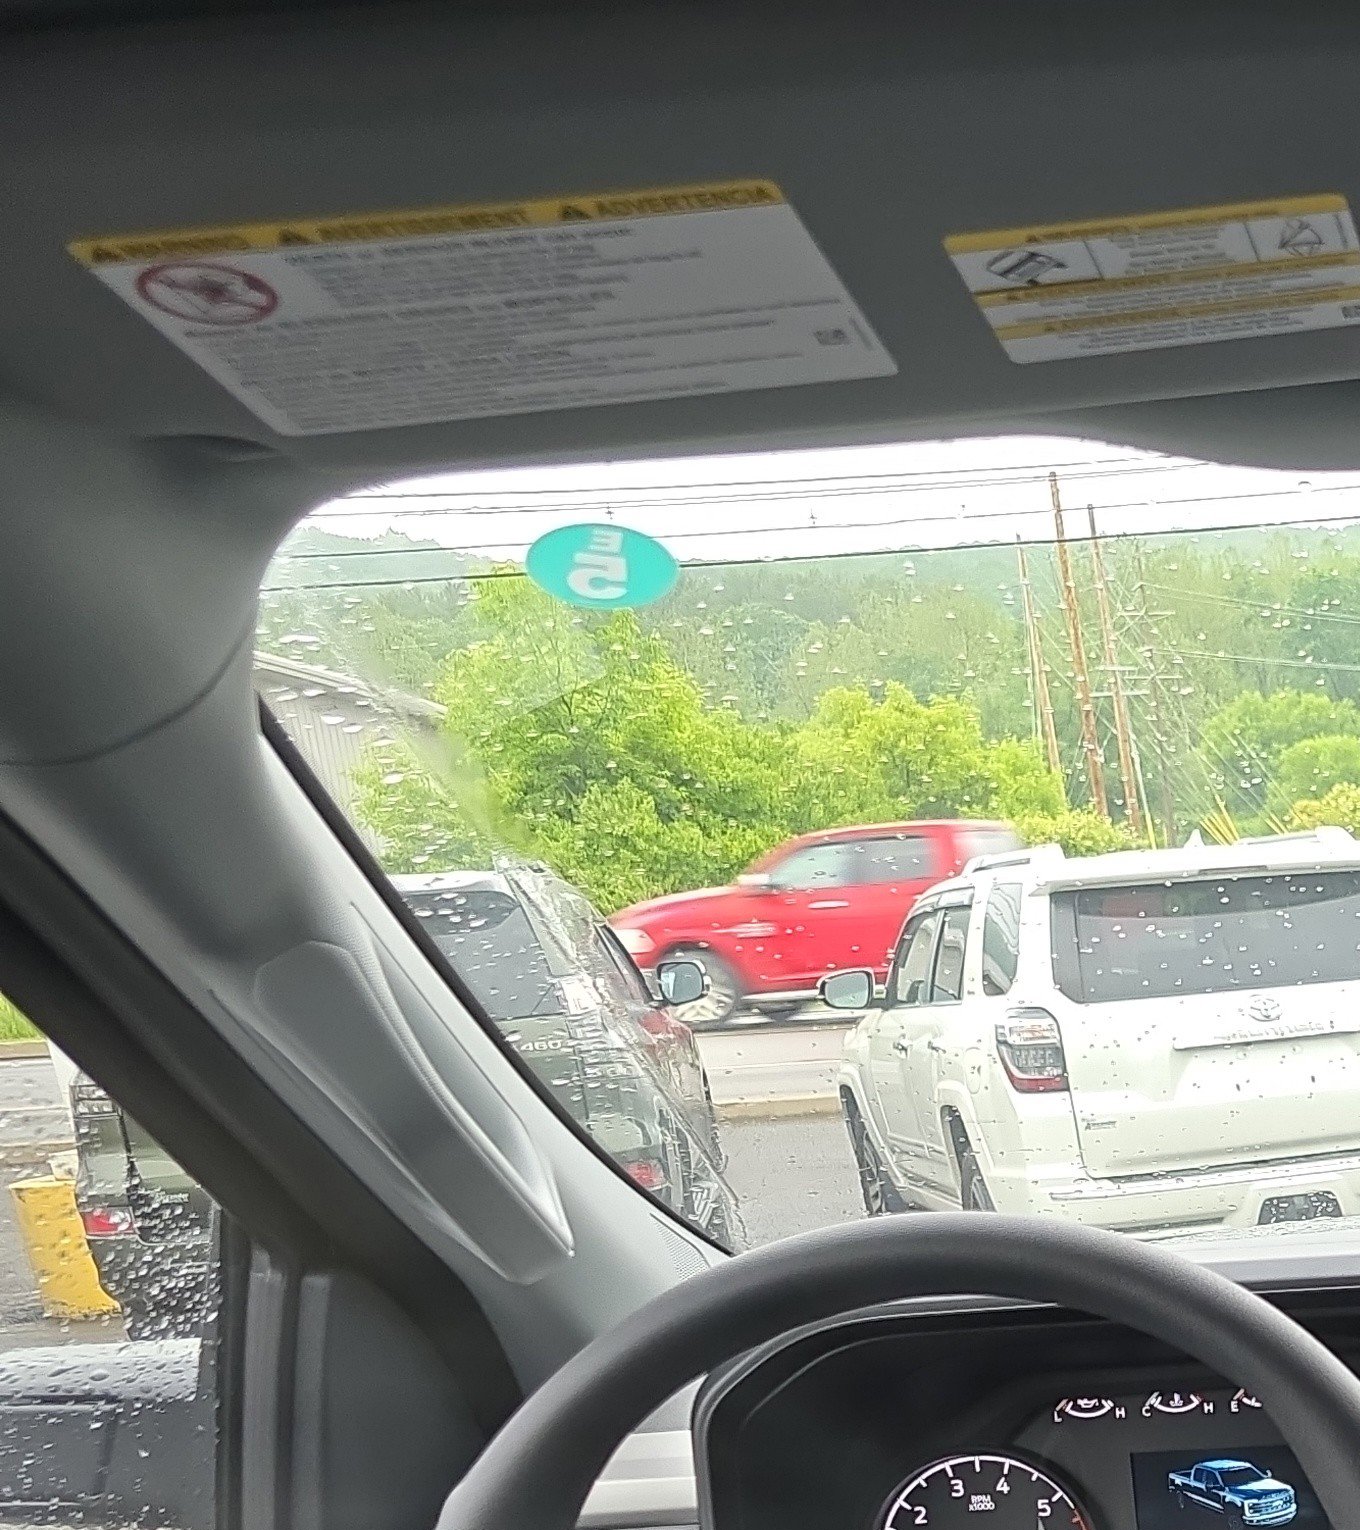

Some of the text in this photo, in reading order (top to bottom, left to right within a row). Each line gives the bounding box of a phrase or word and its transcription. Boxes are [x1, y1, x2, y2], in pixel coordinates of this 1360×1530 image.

[520, 1040, 562, 1052] 460
[1142, 1407, 1152, 1418] C
[1203, 1402, 1214, 1414] H
[1231, 1401, 1239, 1412] E
[1054, 1411, 1063, 1423] L
[1115, 1407, 1126, 1419] H
[950, 1480, 965, 1498] 3
[996, 1476, 1010, 1495] 4
[971, 1494, 992, 1504] RPM
[1037, 1500, 1051, 1517] 5
[914, 1507, 928, 1525] 2
